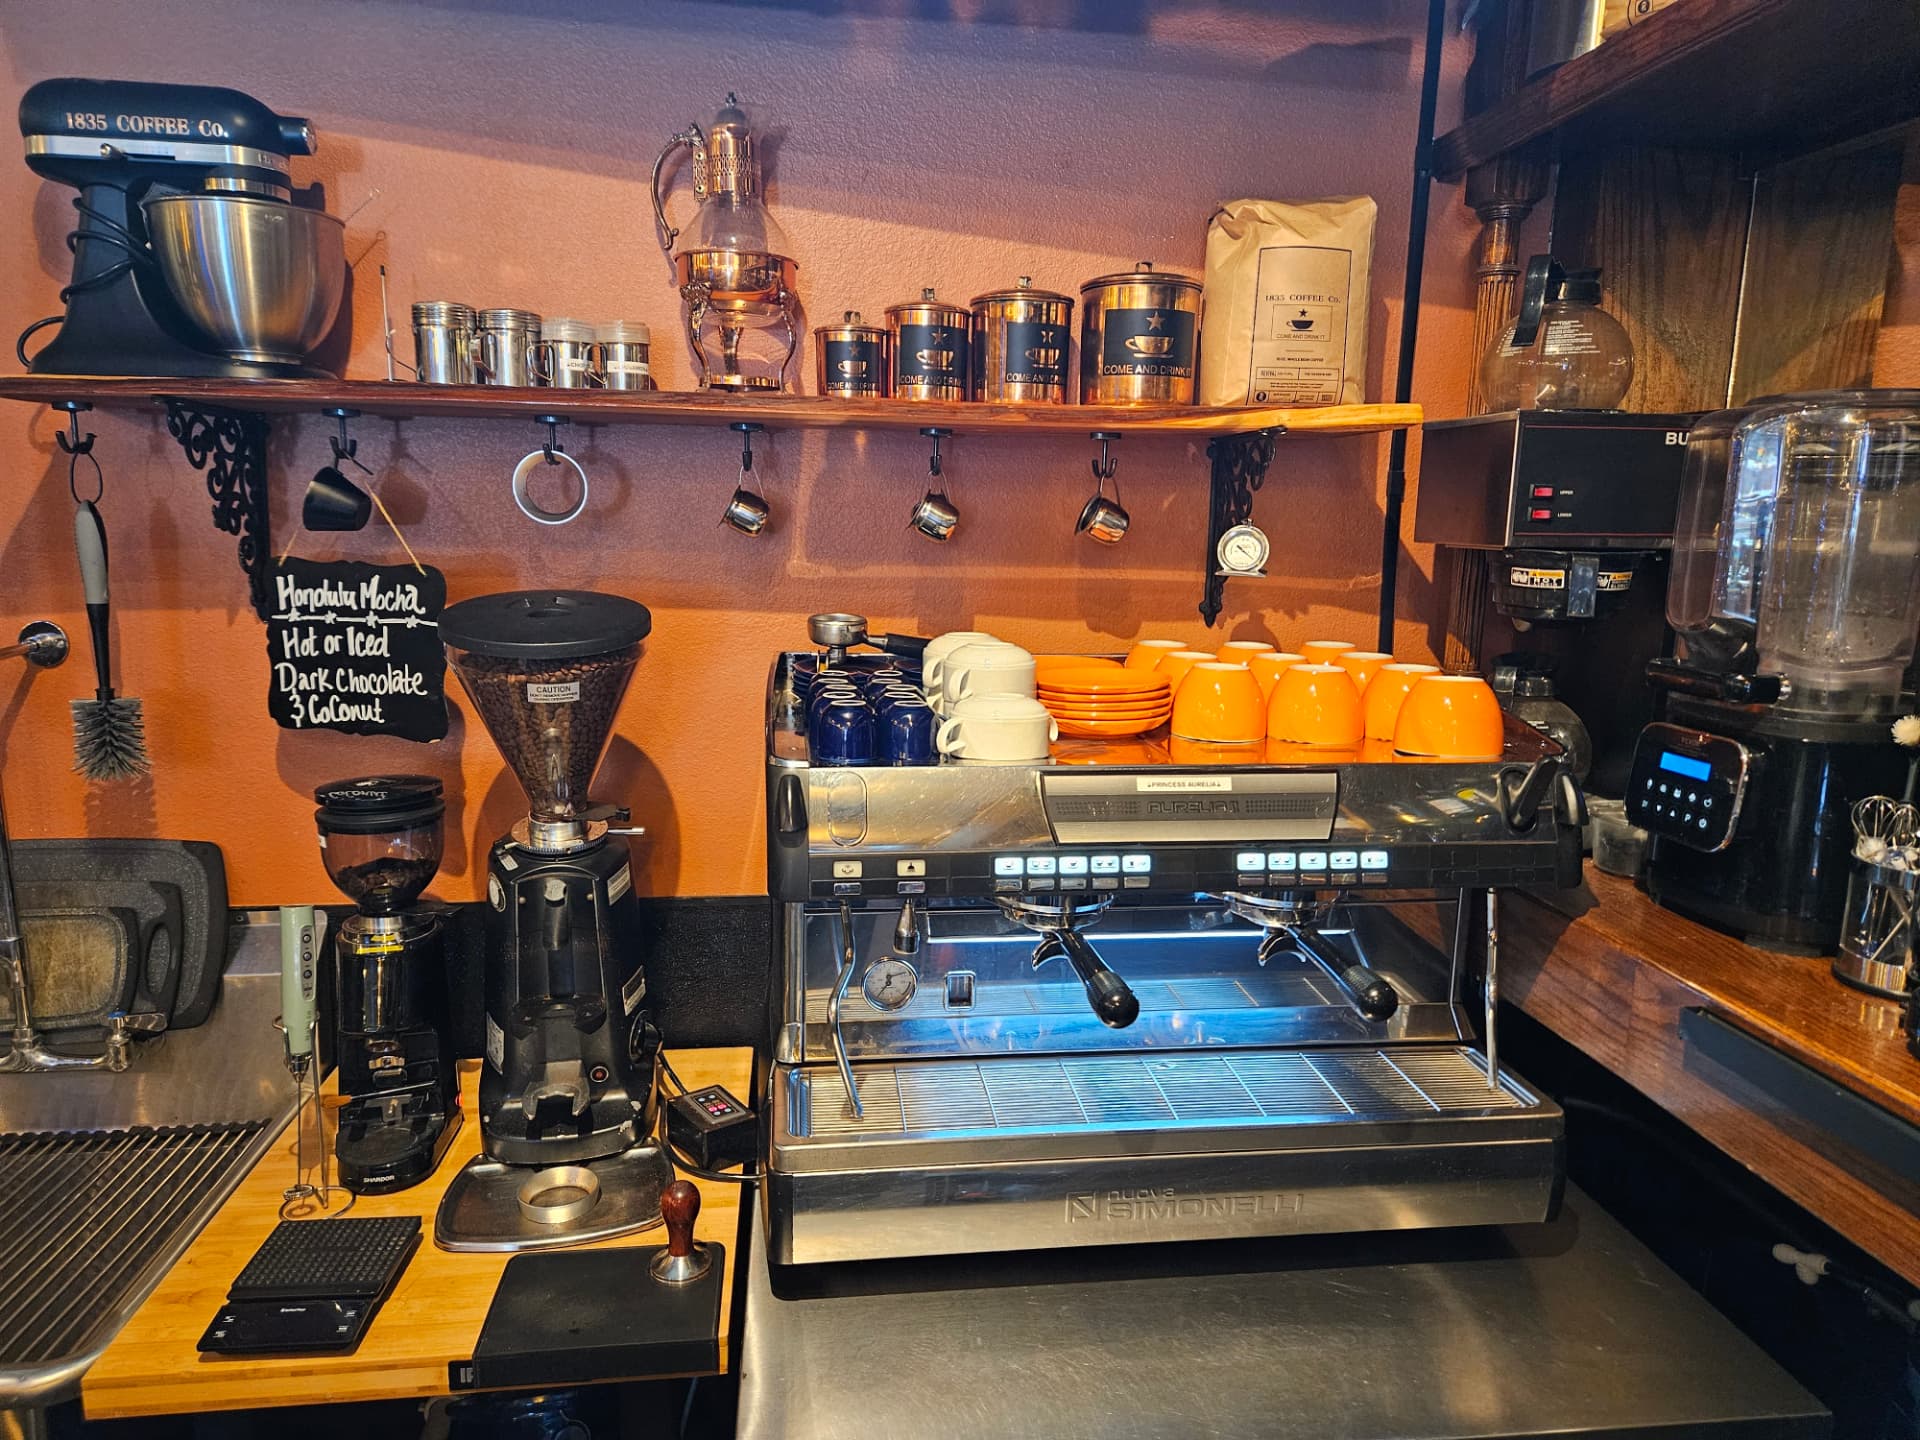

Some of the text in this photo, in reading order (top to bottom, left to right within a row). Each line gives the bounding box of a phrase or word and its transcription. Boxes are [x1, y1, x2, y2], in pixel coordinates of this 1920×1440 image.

[65, 112, 229, 138] 1835 COFFEE Co.
[1289, 294, 1324, 302] COFFEE
[1103, 364, 1134, 375] COME
[1134, 364, 1158, 375] AND
[1160, 365, 1186, 376] DRINK
[899, 374, 923, 385] COME
[924, 375, 942, 386] AND
[1006, 372, 1032, 382] COME
[827, 381, 844, 390] COME
[1664, 431, 1691, 446] BU
[276, 574, 426, 614] Honolulu Mocha
[282, 626, 390, 659] Hot or Iced
[274, 662, 428, 696] Dark Chocolate
[1148, 800, 1228, 814] AURELIA
[363, 1175, 395, 1183] SHARDOR
[1107, 1188, 1175, 1201] nuova
[1107, 1193, 1304, 1221] SIMONELLI
